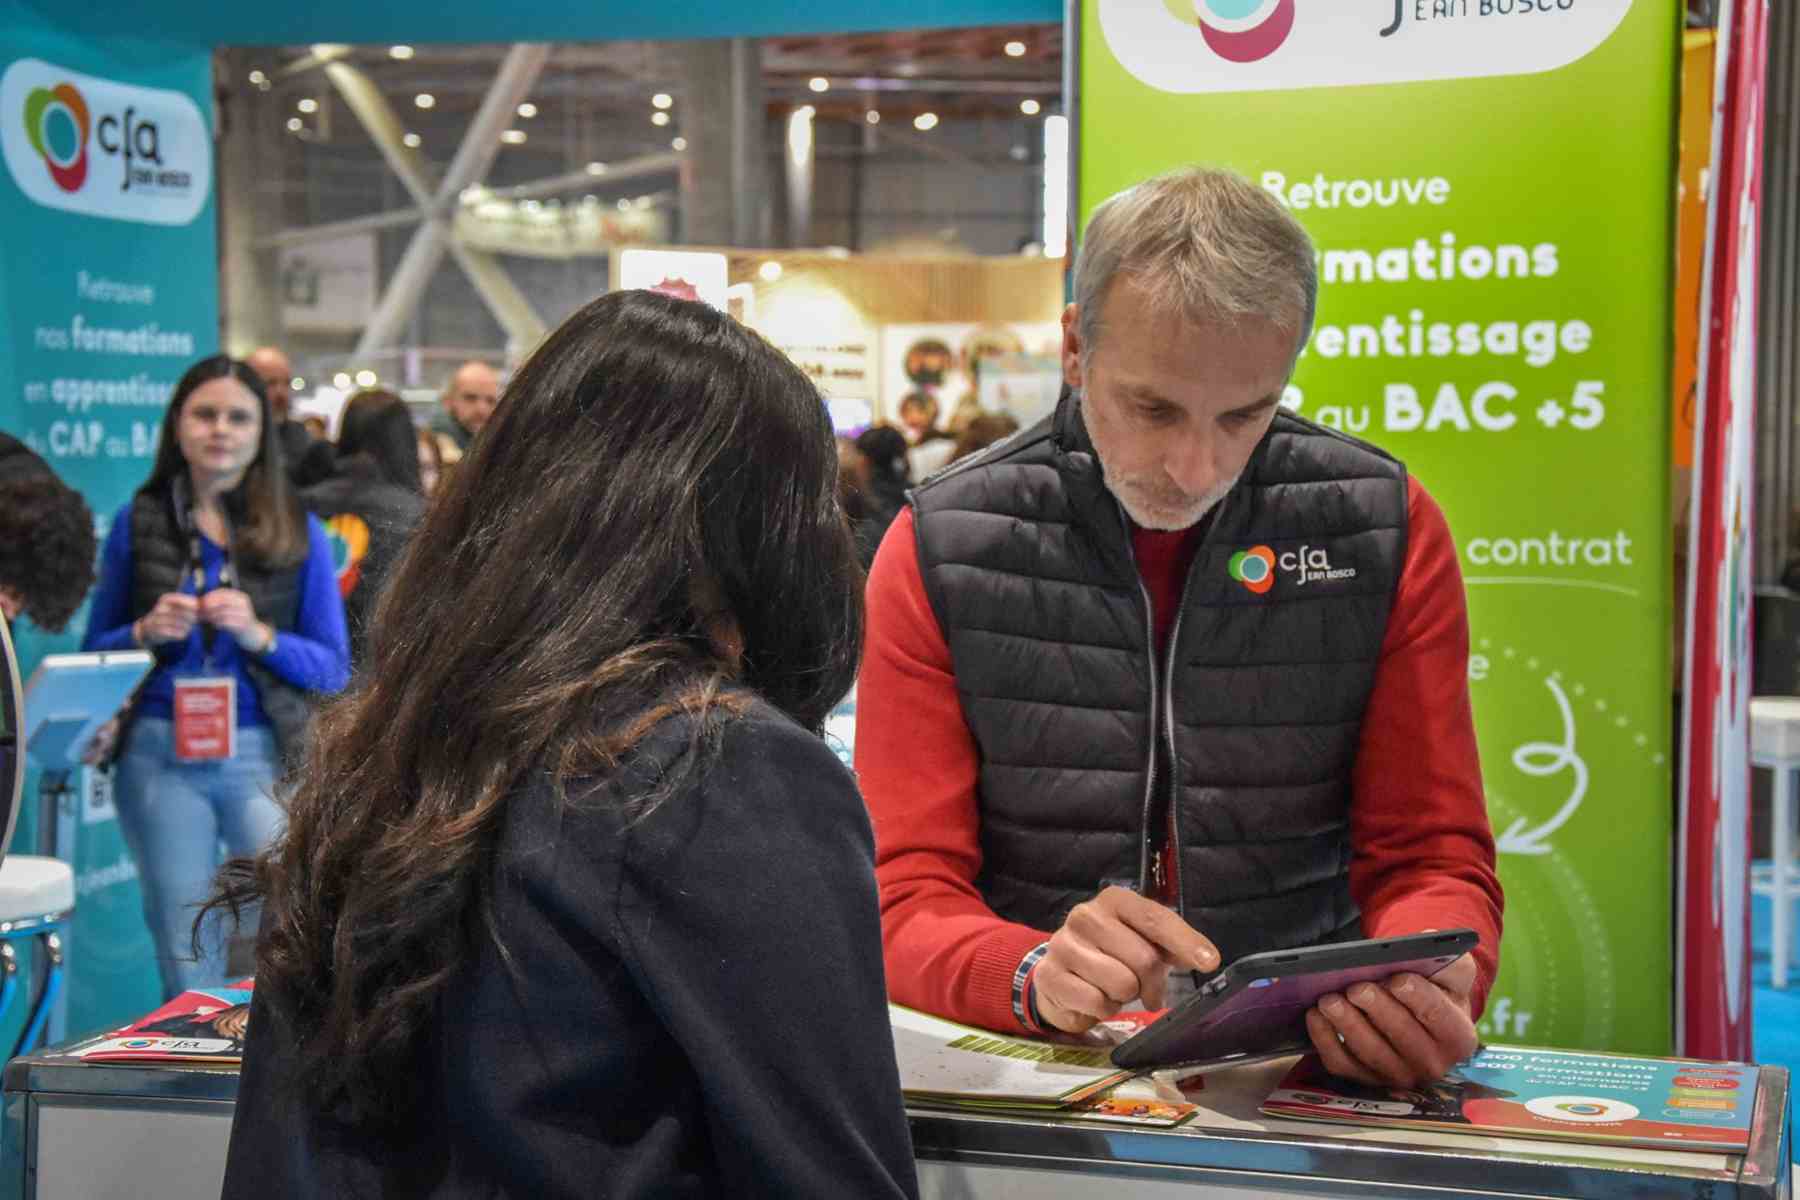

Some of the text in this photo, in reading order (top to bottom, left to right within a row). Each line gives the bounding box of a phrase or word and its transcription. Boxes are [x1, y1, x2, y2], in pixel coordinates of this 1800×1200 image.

[1480, 0, 1574, 16] BOSCO
[97, 106, 163, 191] cfa
[1261, 171, 1451, 209] Retrouve
[1314, 232, 1559, 284] mations
[1314, 380, 1605, 432] au BAC +5
[49, 421, 104, 457] CAP
[1280, 545, 1331, 585] cfa
[1466, 530, 1633, 567] contrat
[1326, 567, 1356, 579] BOSCO
[1523, 1063, 1654, 1080] formations
